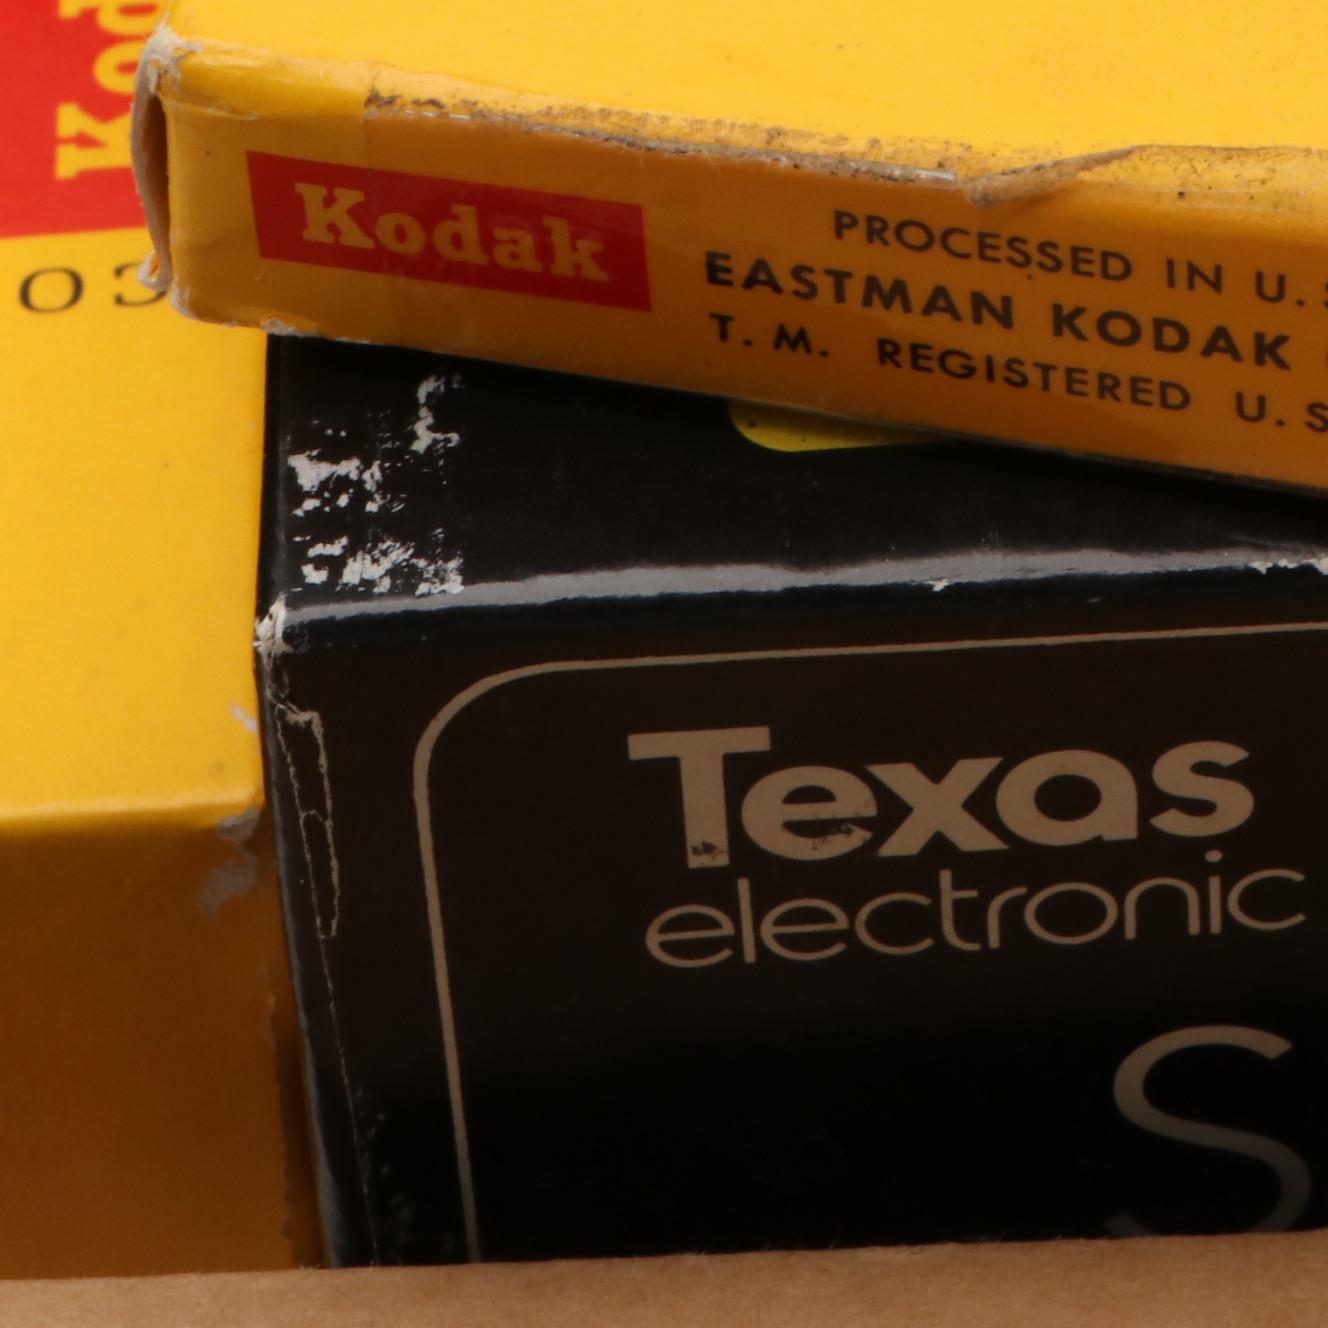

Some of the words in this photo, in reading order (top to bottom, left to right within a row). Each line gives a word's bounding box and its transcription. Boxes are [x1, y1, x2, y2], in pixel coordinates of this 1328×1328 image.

[294, 181, 609, 283] Kodak
[833, 210, 1133, 283] PROCESSED
[1166, 258, 1223, 294] IN
[704, 251, 1014, 329] EASTMAN
[1052, 302, 1291, 370] KODAK
[877, 337, 1191, 411] REGISTERED
[627, 725, 1255, 869] Texas
[645, 850, 1306, 968] electronic
